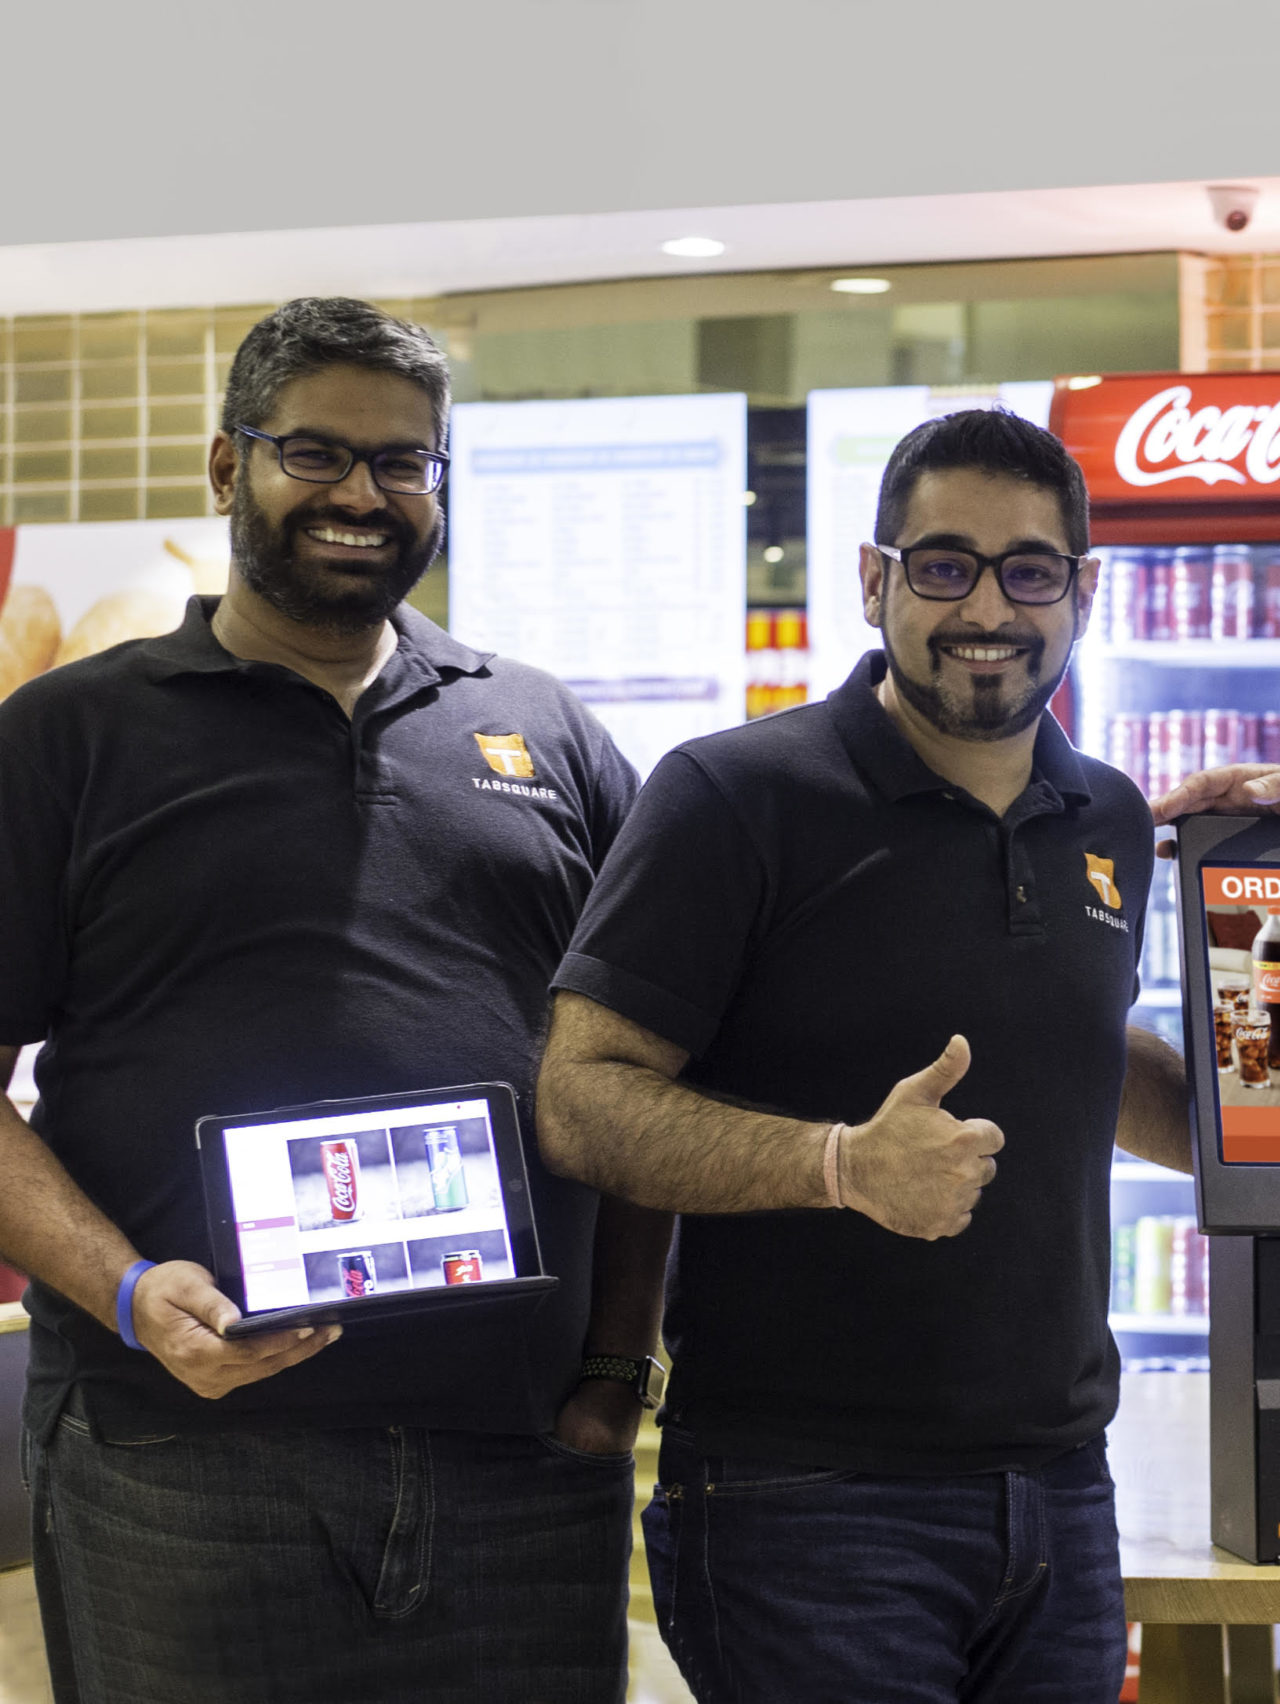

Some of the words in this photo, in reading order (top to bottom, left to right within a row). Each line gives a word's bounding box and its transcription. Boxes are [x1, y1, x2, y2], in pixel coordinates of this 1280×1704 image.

[485, 747, 522, 776] T
[471, 777, 557, 800] TABSQUARE
[1090, 871, 1111, 905] T
